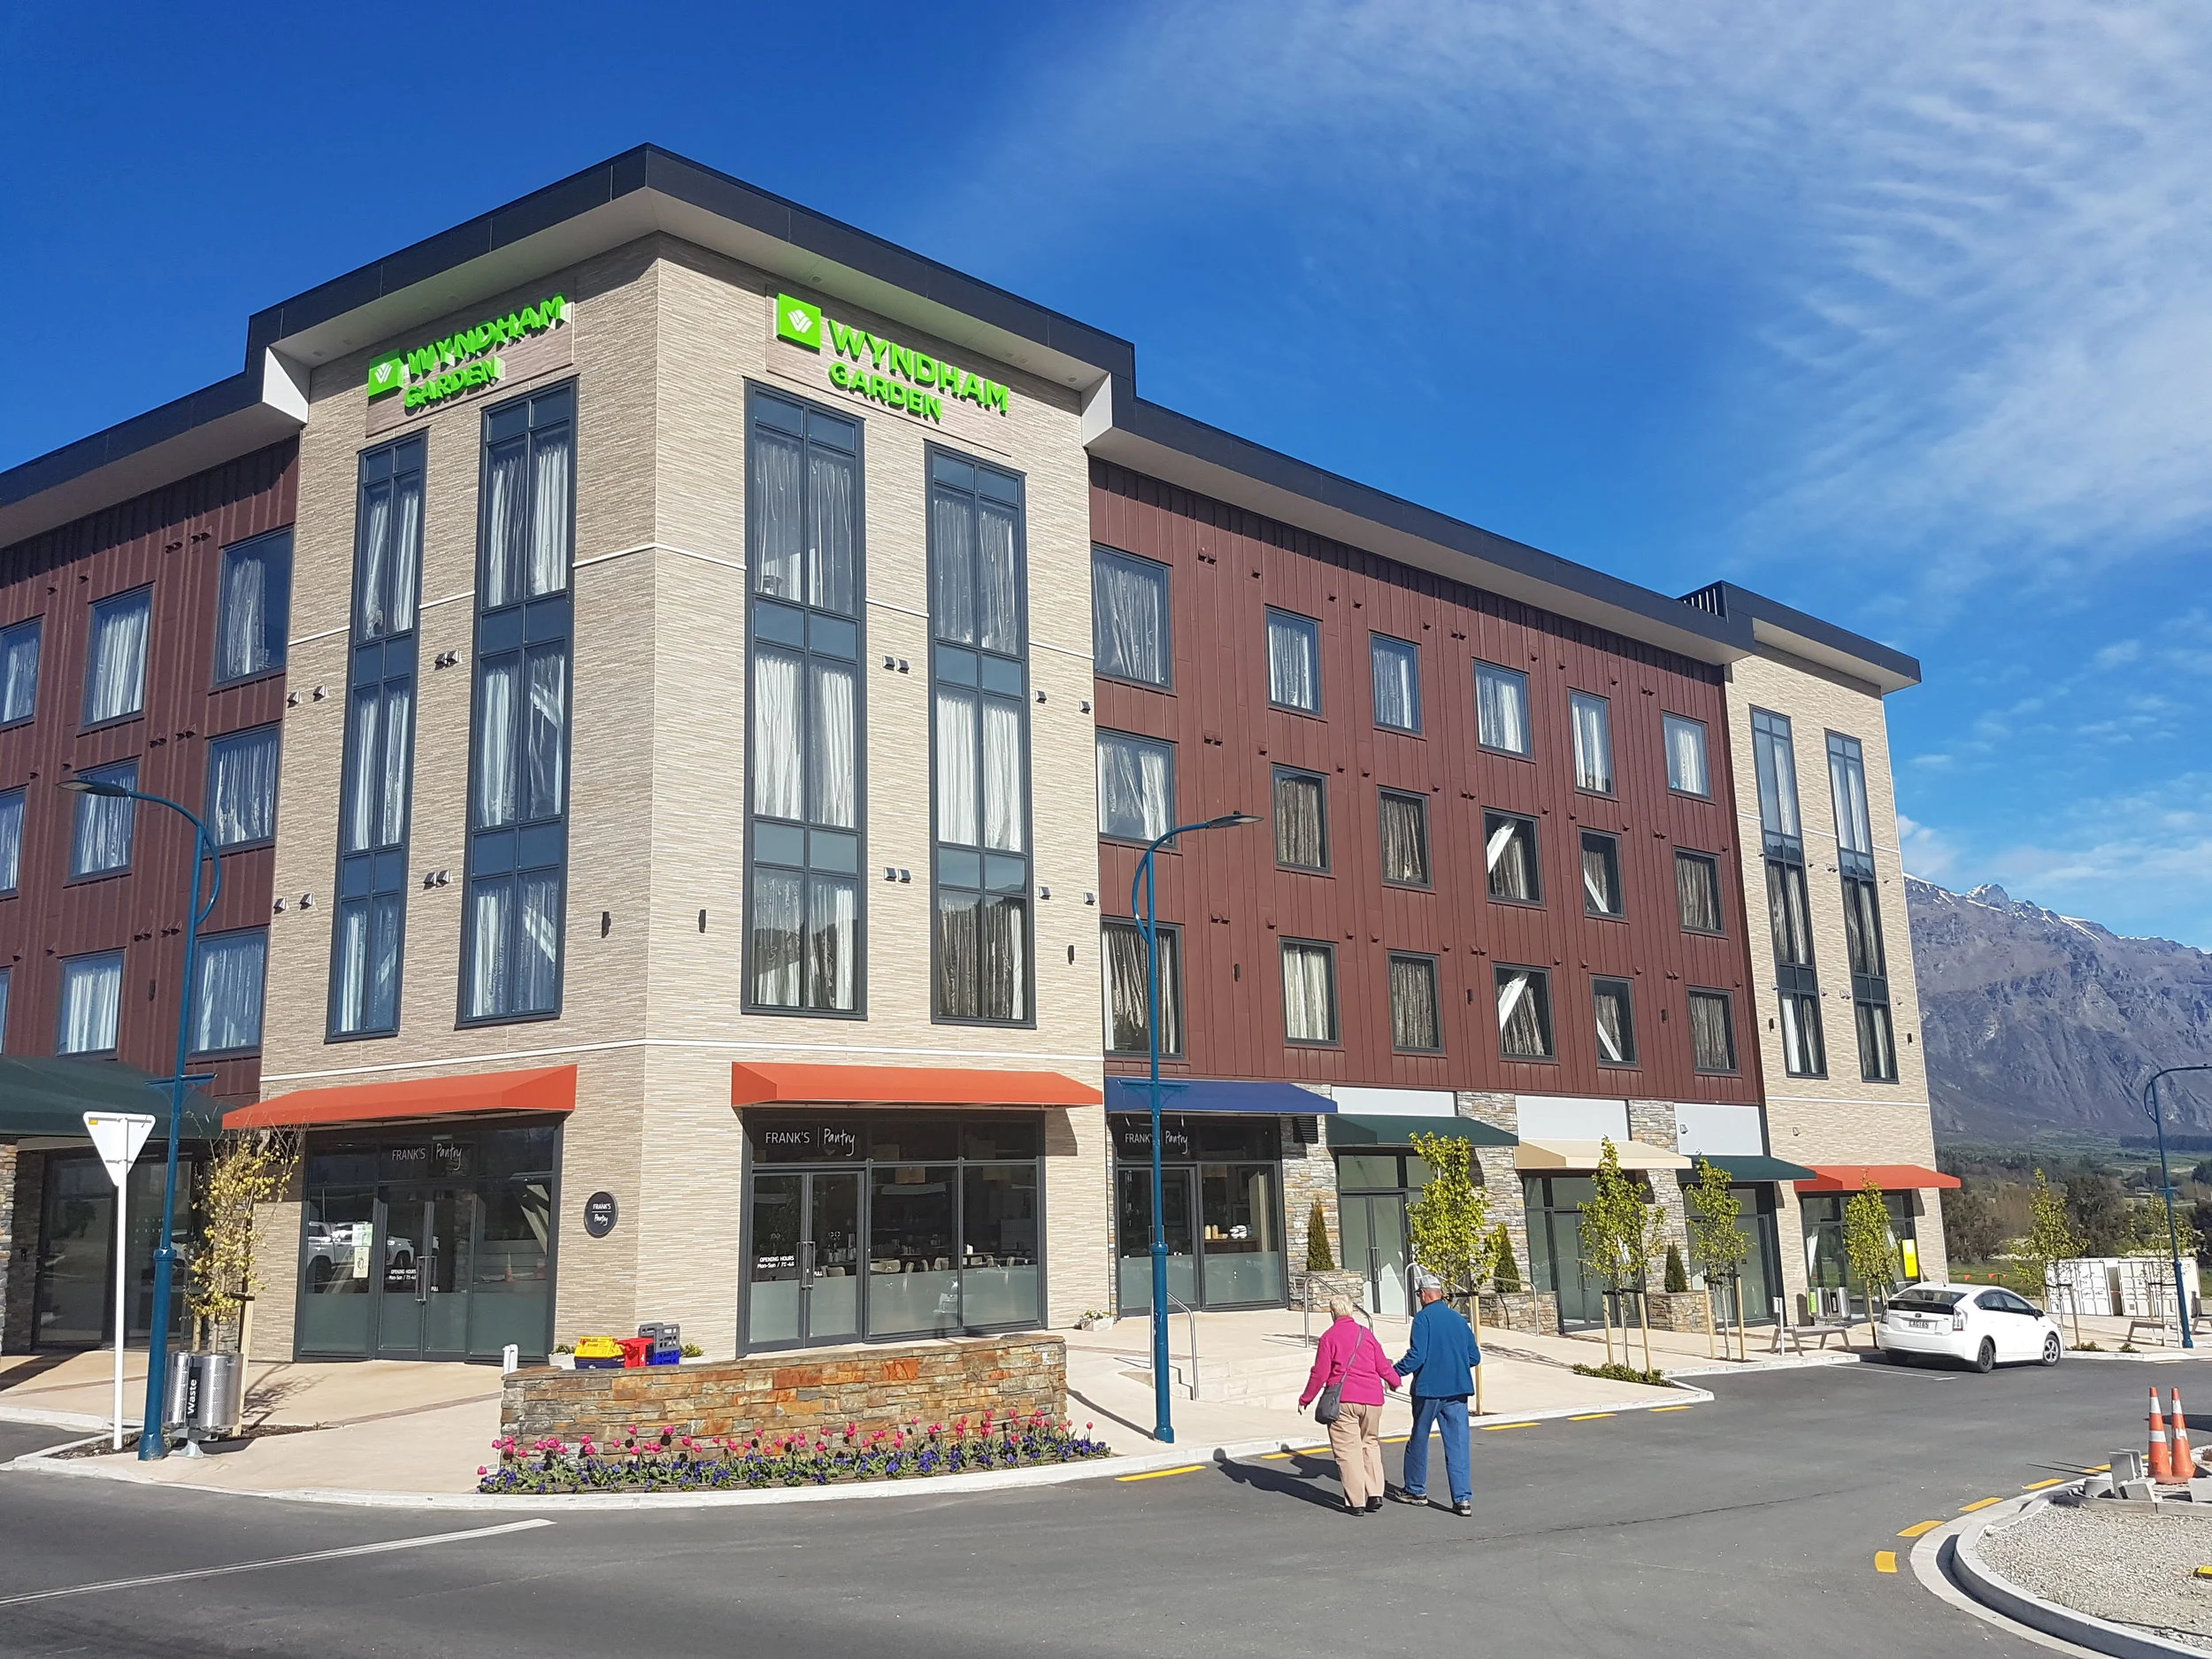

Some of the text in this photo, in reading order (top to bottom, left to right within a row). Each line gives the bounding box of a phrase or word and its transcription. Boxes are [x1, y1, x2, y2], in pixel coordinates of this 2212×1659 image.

[406, 292, 569, 376] WYNDHAM
[404, 355, 502, 408] GARDEN
[828, 319, 1009, 415] WYNDHAM
[828, 361, 942, 422] GARDEN
[392, 1142, 463, 1171] FRANK'S Pantry
[765, 1127, 856, 1156] FRANK'S Pantry
[1165, 1130, 1188, 1155] Pantry
[187, 1379, 197, 1415] Waste
